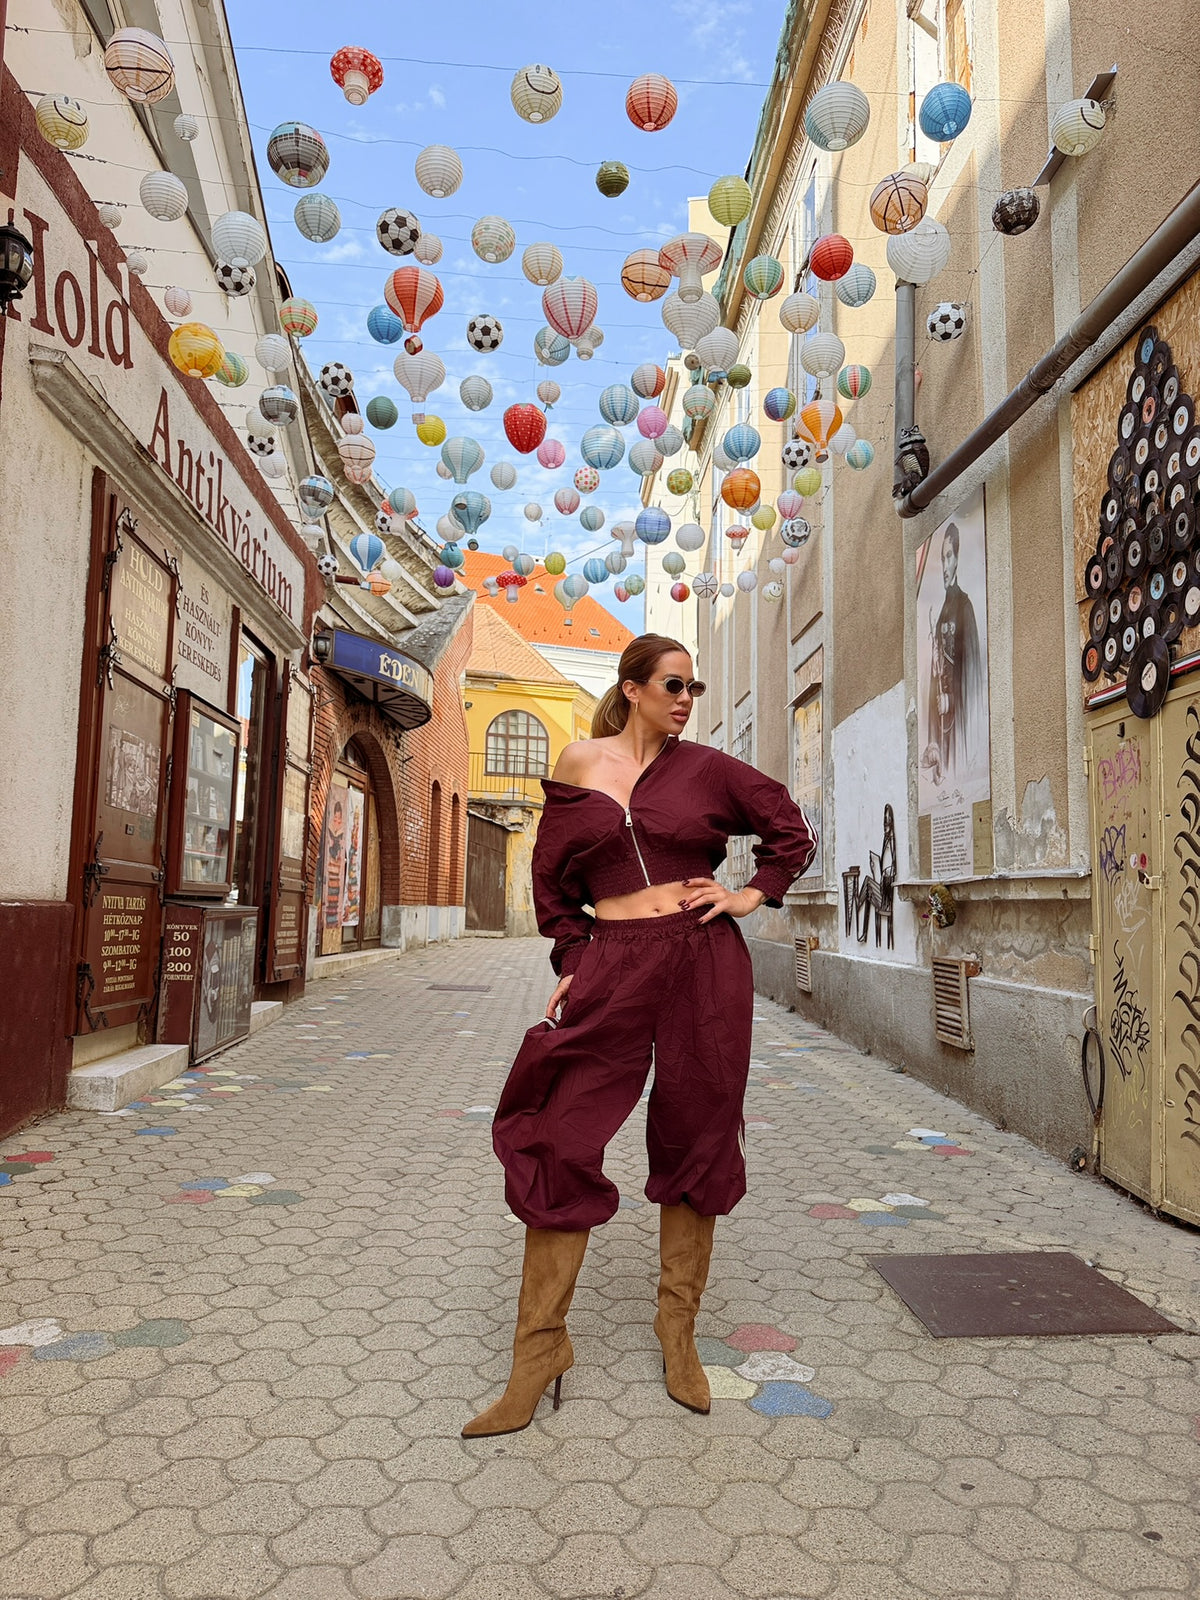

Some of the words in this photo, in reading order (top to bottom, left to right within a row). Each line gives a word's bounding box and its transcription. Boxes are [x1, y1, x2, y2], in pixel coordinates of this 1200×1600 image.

[147, 386, 293, 620] Antikvárium
[129, 546, 163, 592] HOLD
[200, 583, 209, 605] ÉS
[173, 931, 190, 942] 50
[169, 946, 191, 957] 100
[166, 961, 192, 972] 200
